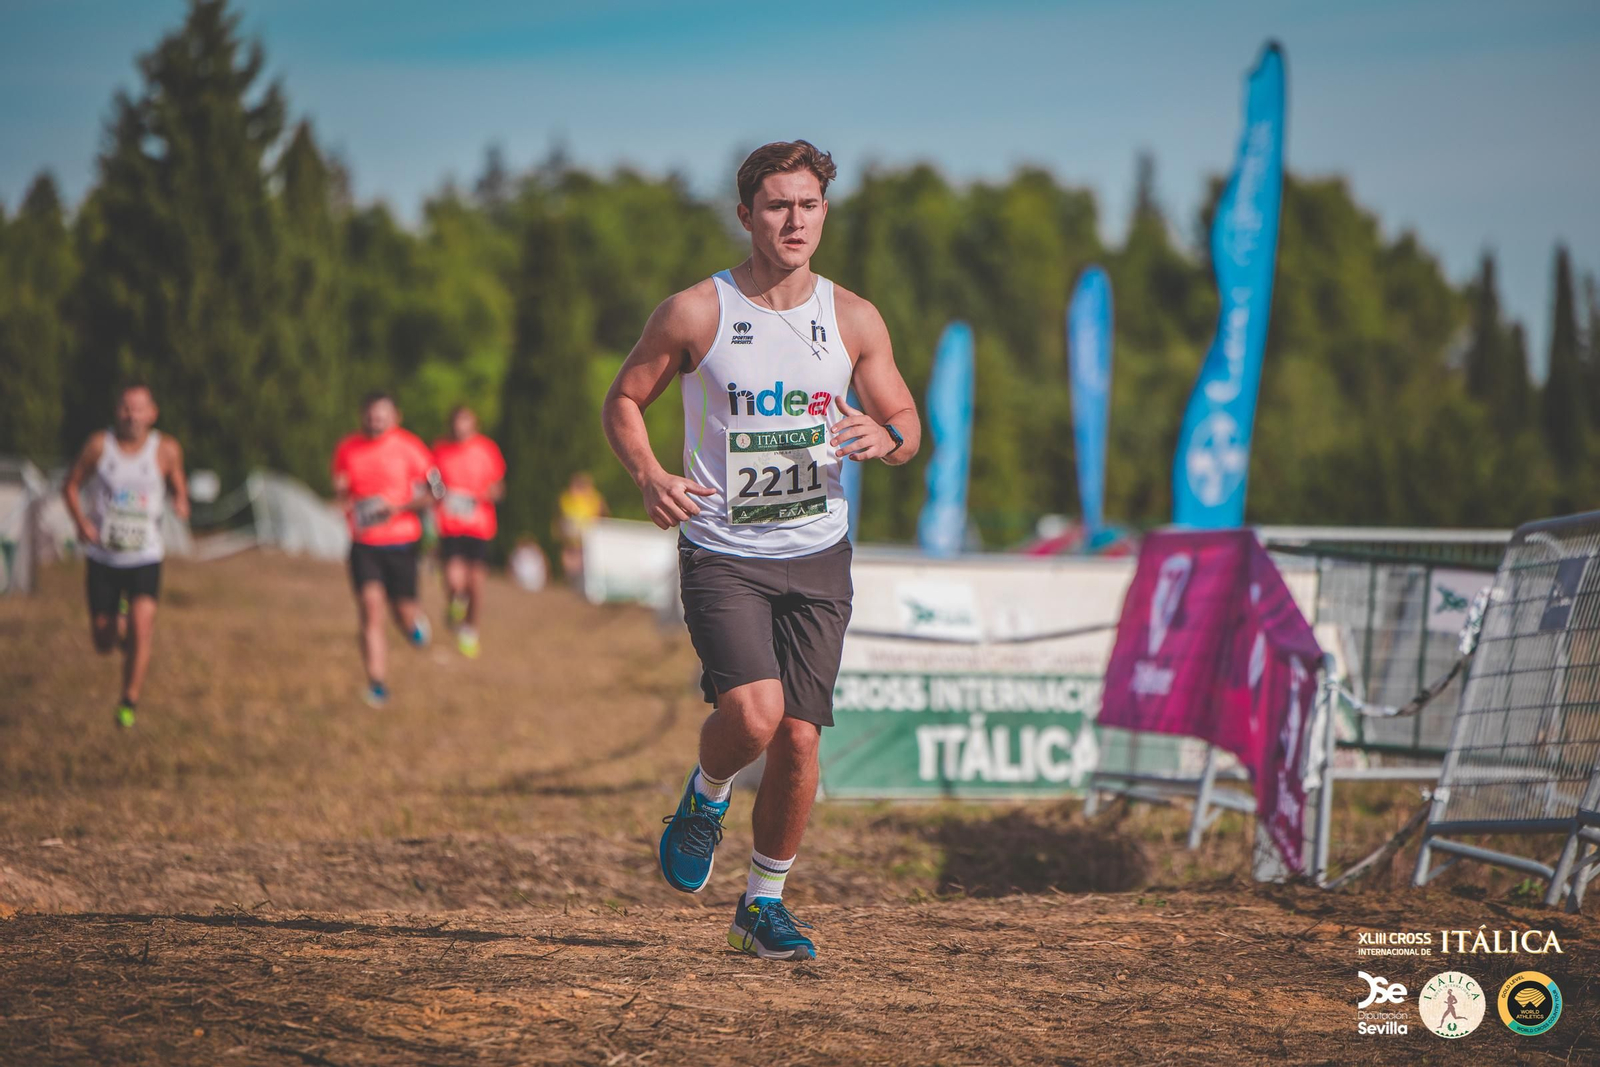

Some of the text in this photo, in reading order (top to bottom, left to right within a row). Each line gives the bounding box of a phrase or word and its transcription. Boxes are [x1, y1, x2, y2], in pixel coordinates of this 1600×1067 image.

[727, 381, 832, 416] indea
[758, 432, 806, 446] ITÁLICA
[738, 460, 822, 498] 2211
